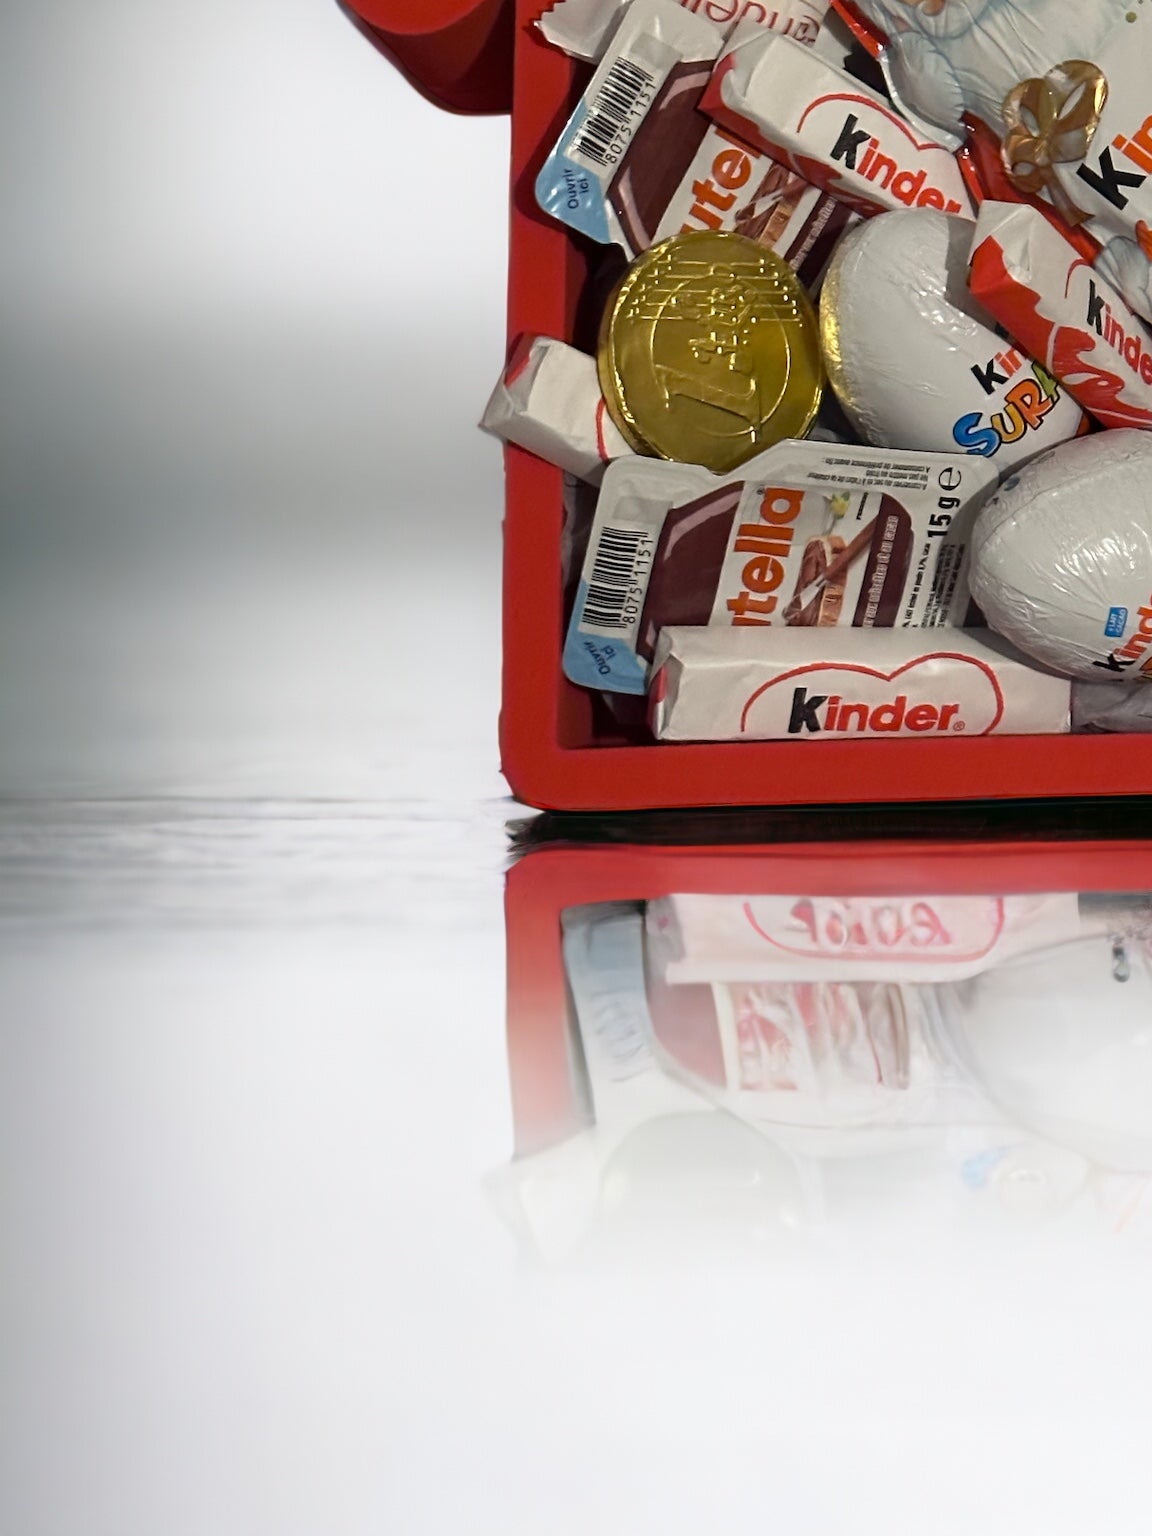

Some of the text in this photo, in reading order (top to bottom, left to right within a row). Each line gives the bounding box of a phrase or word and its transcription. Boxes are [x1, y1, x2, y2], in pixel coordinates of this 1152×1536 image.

[563, 169, 579, 209] Ouvrir
[577, 178, 589, 194] ici
[938, 497, 960, 510] g
[927, 514, 952, 537] 15
[726, 487, 805, 626] tella
[584, 640, 611, 675] Ouvrir
